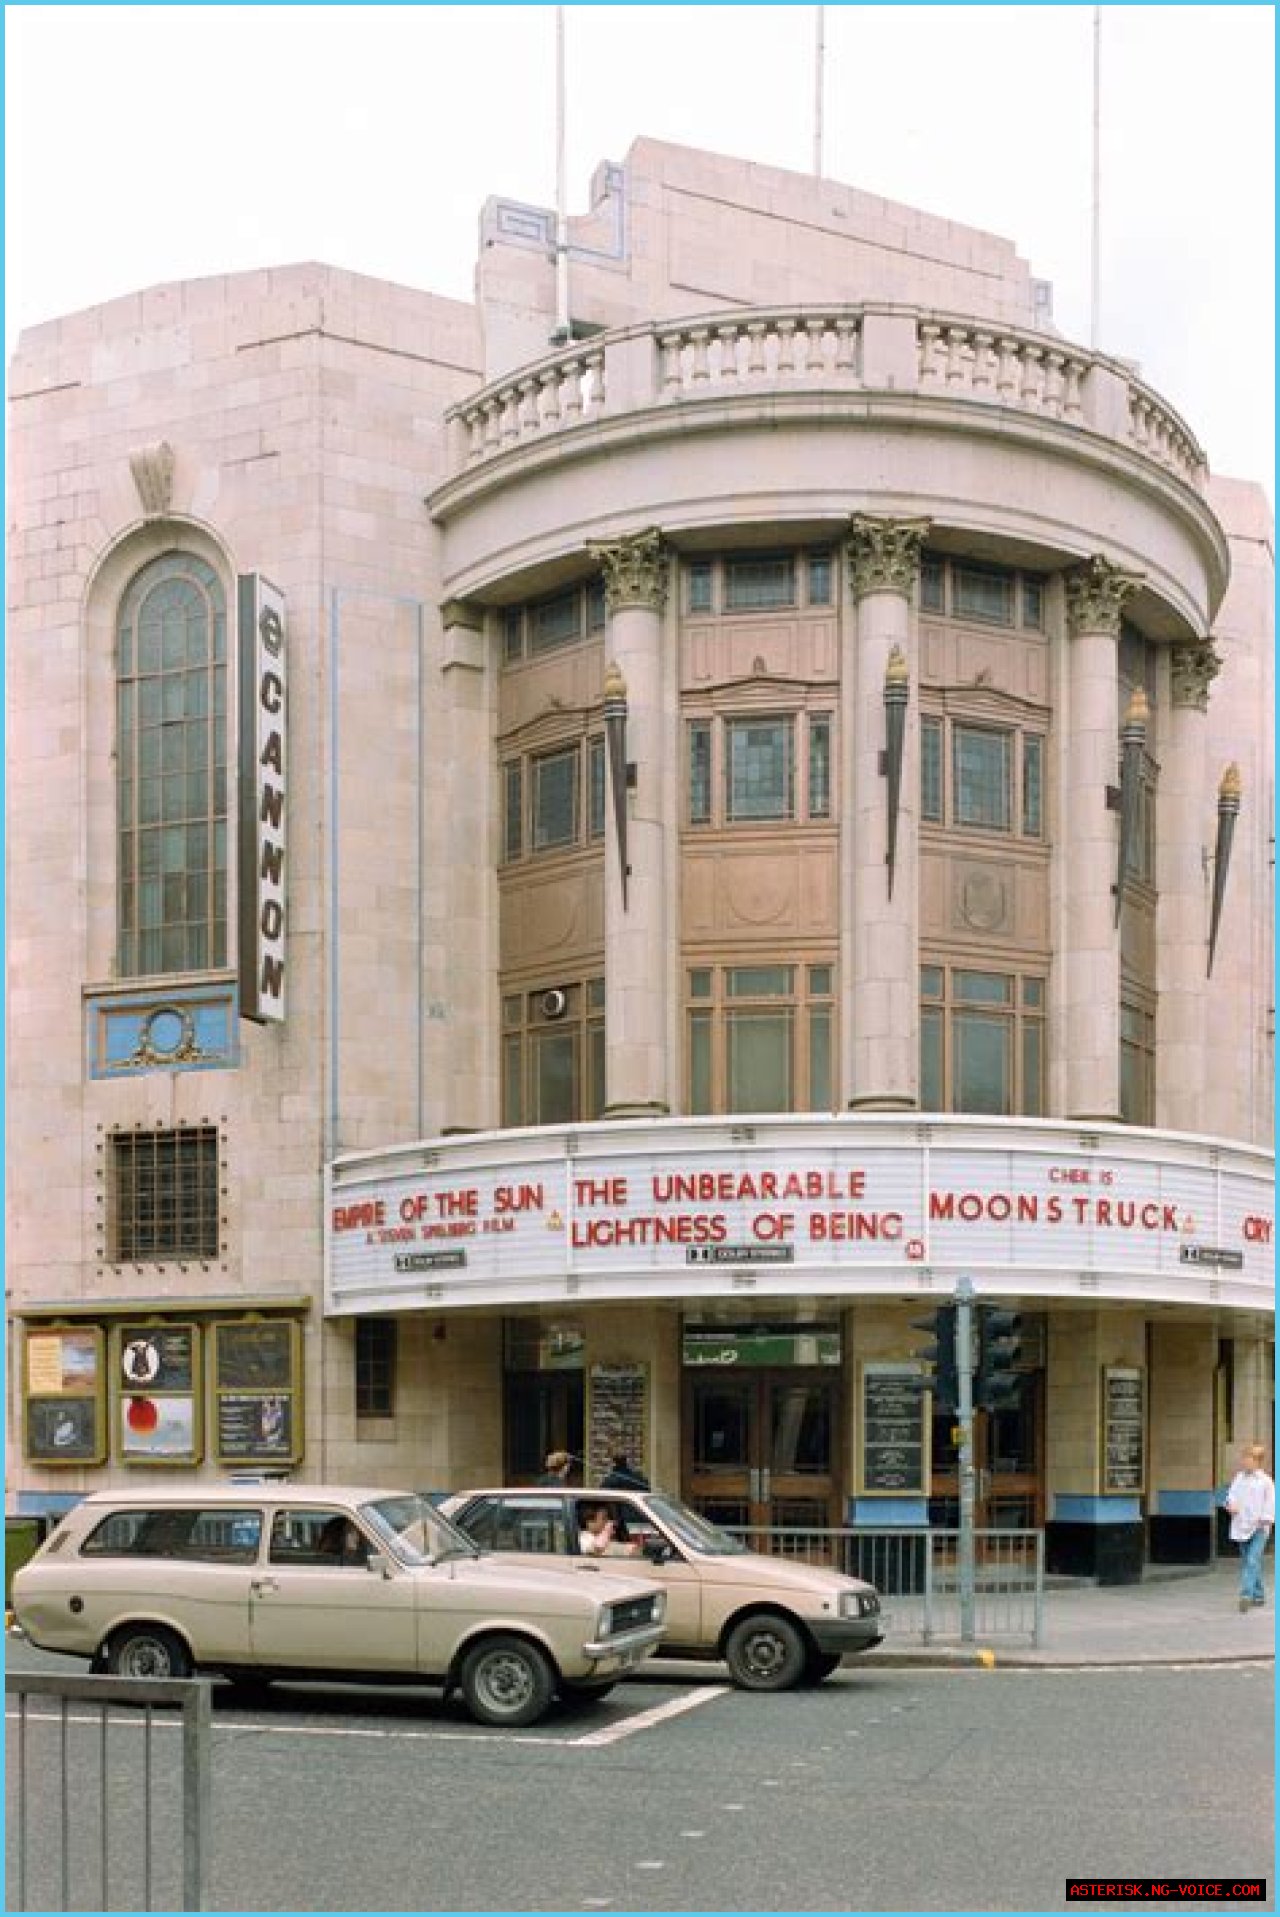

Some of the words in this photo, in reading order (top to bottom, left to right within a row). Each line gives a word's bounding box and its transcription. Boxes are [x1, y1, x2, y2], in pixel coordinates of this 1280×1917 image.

[261, 671, 284, 998] CANNON
[400, 1195, 428, 1223] OF
[434, 1189, 478, 1218] THE
[493, 1182, 543, 1213] SUN
[574, 1178, 628, 1207] THE
[652, 1170, 866, 1202] UNBEARABLE
[571, 1213, 728, 1248] LIGHTNESS
[752, 1212, 795, 1241] OF
[809, 1212, 904, 1242] BEING
[928, 1192, 1178, 1232] MOONSTRUCK
